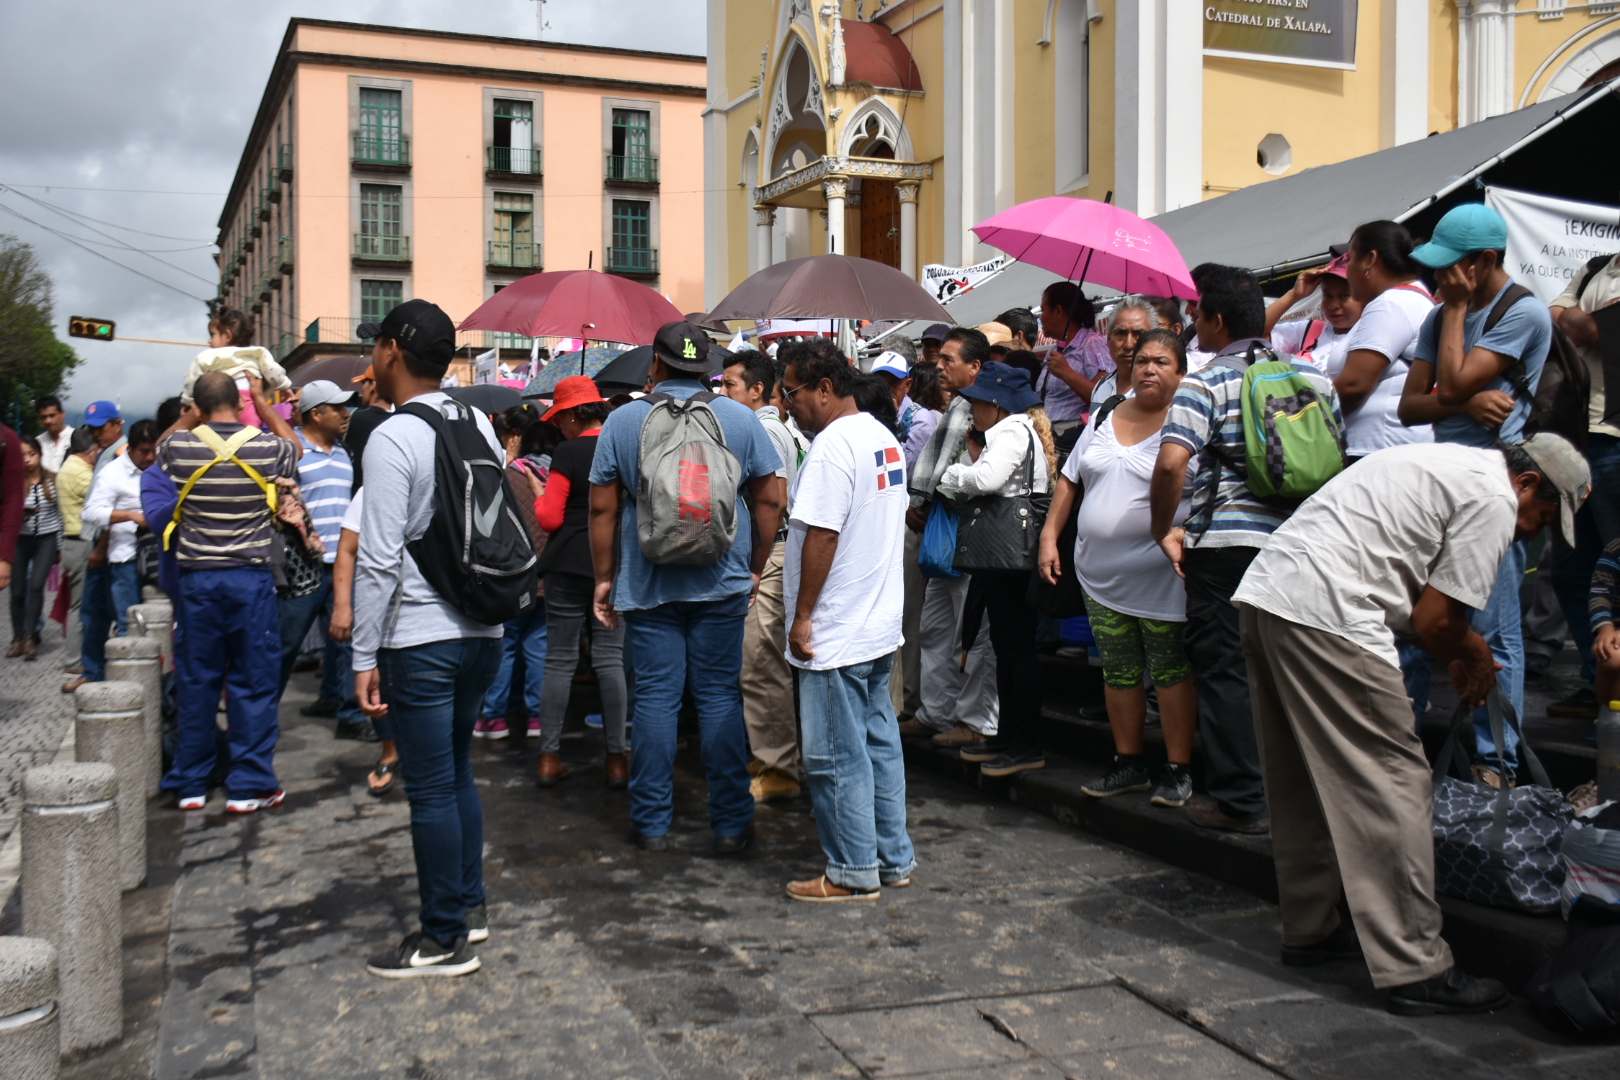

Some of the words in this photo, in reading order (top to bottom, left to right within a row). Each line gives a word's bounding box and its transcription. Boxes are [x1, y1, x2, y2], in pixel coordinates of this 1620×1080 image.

[1205, 7, 1263, 26] CATEDRAL
[1266, 17, 1281, 28] DE
[1284, 16, 1332, 34] XALAPA.
[1541, 244, 1549, 255] A
[1552, 246, 1565, 258] LA
[1568, 248, 1613, 261] INSTIT
[1520, 263, 1535, 275] YA
[1538, 265, 1559, 278] QUE
[683, 338, 697, 359] LA
[678, 459, 711, 525] NIKE
